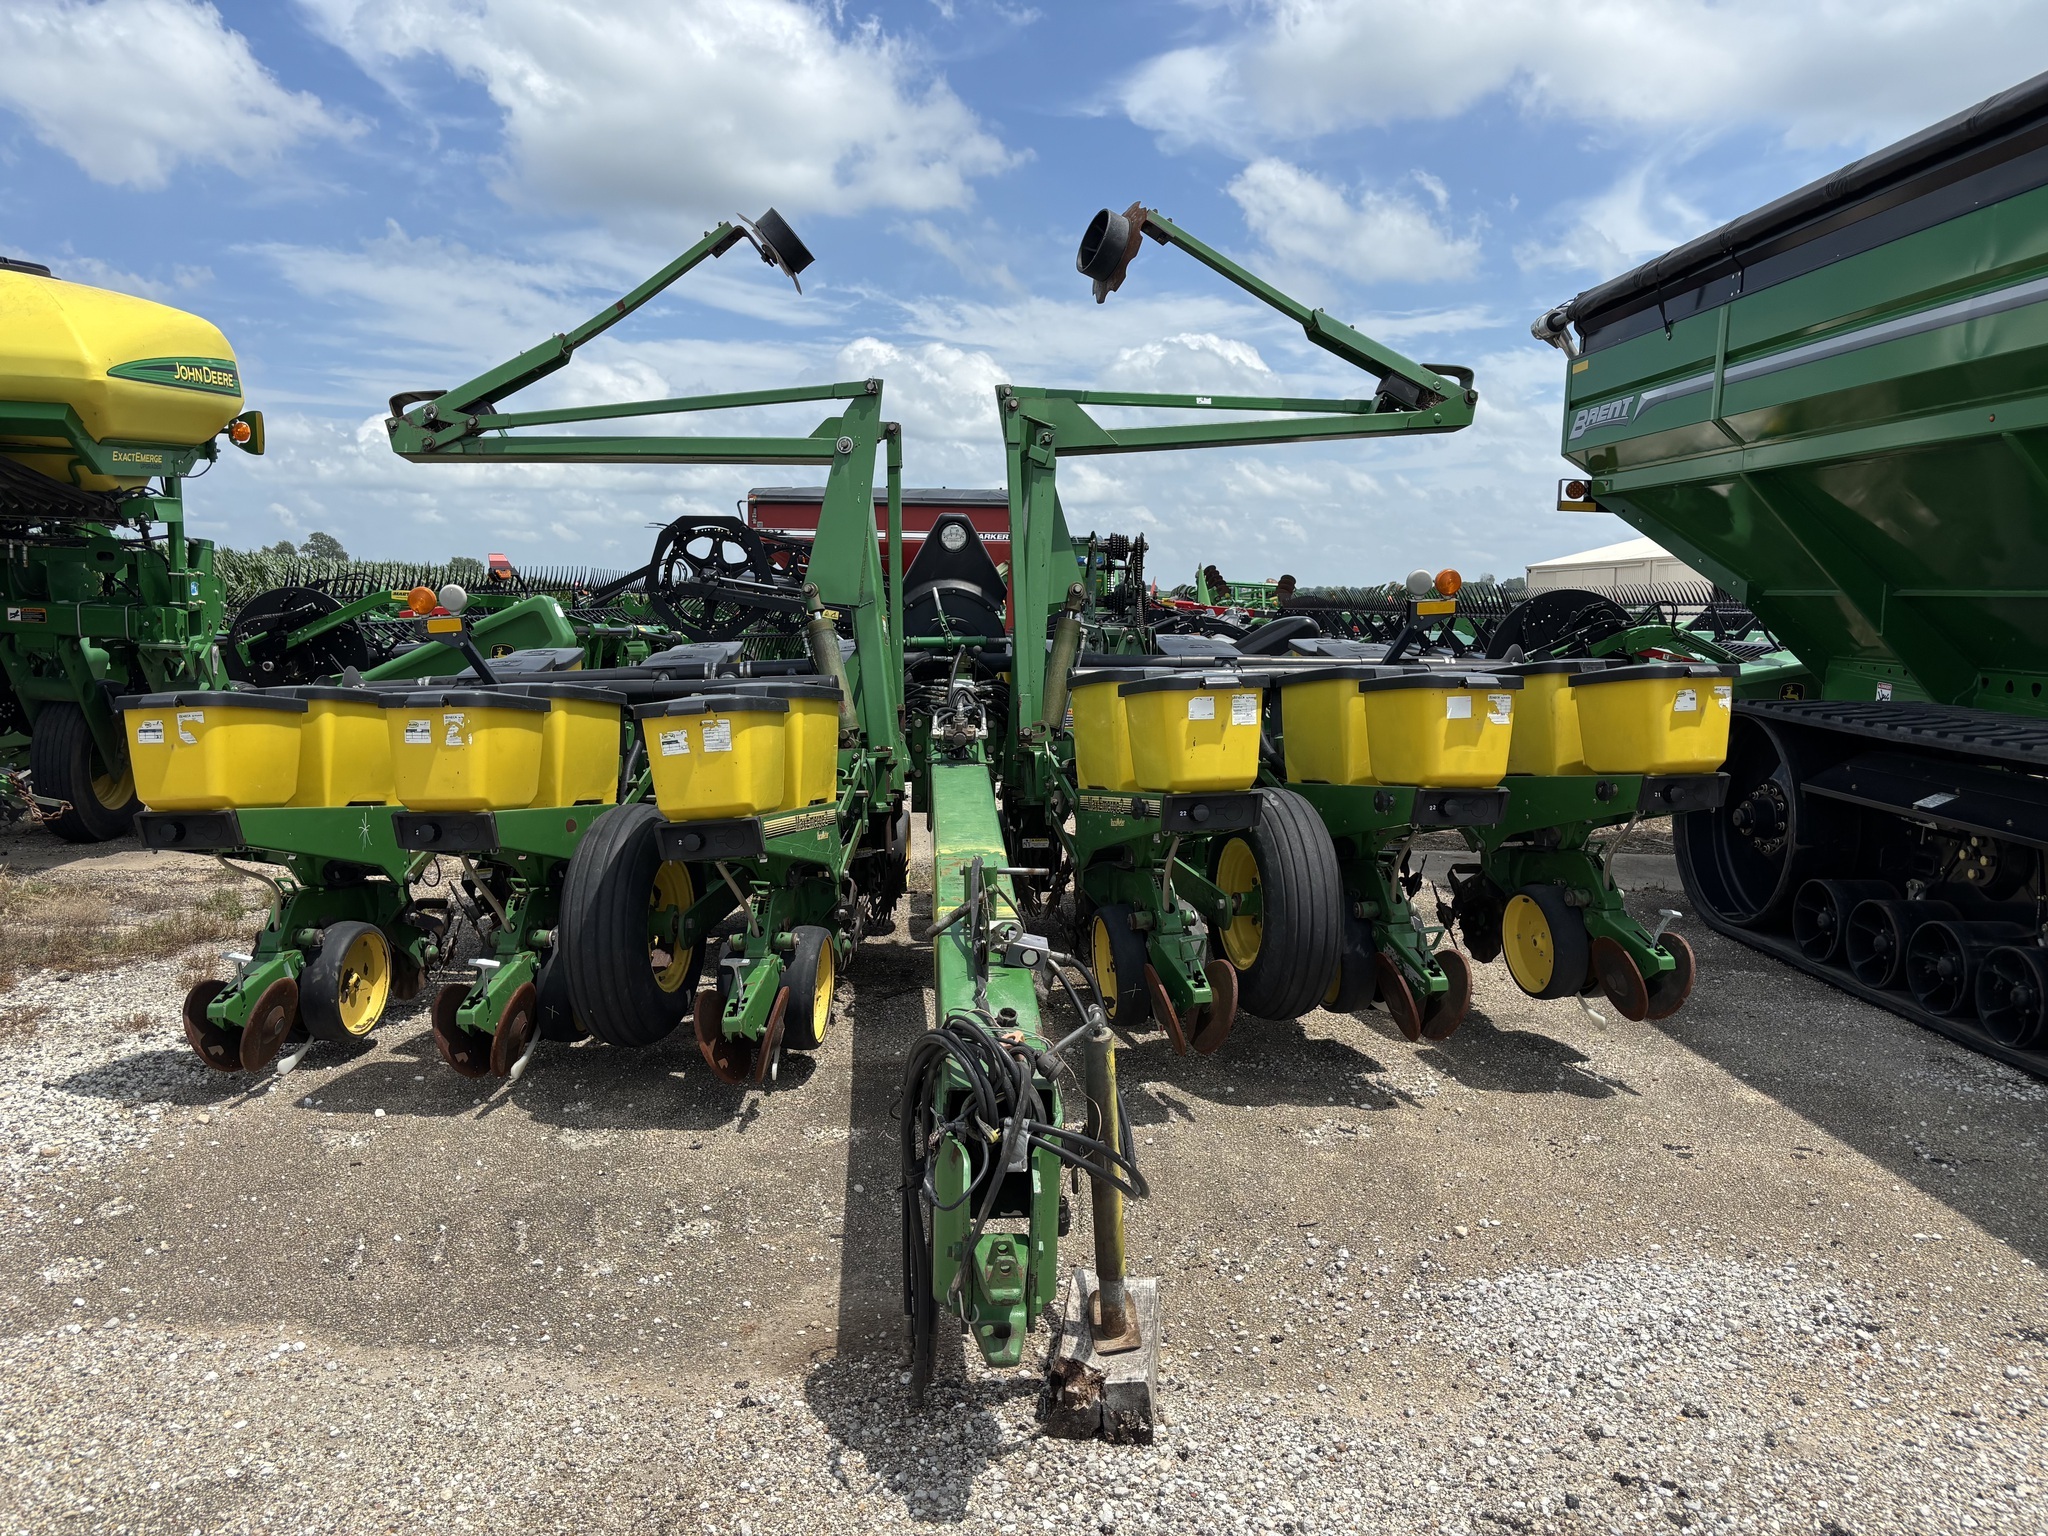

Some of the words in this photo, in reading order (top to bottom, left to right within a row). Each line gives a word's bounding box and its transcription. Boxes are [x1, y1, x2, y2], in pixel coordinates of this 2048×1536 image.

[174, 361, 204, 383] JOHN
[203, 366, 234, 387] DEERE
[1568, 396, 1634, 440] BRENT
